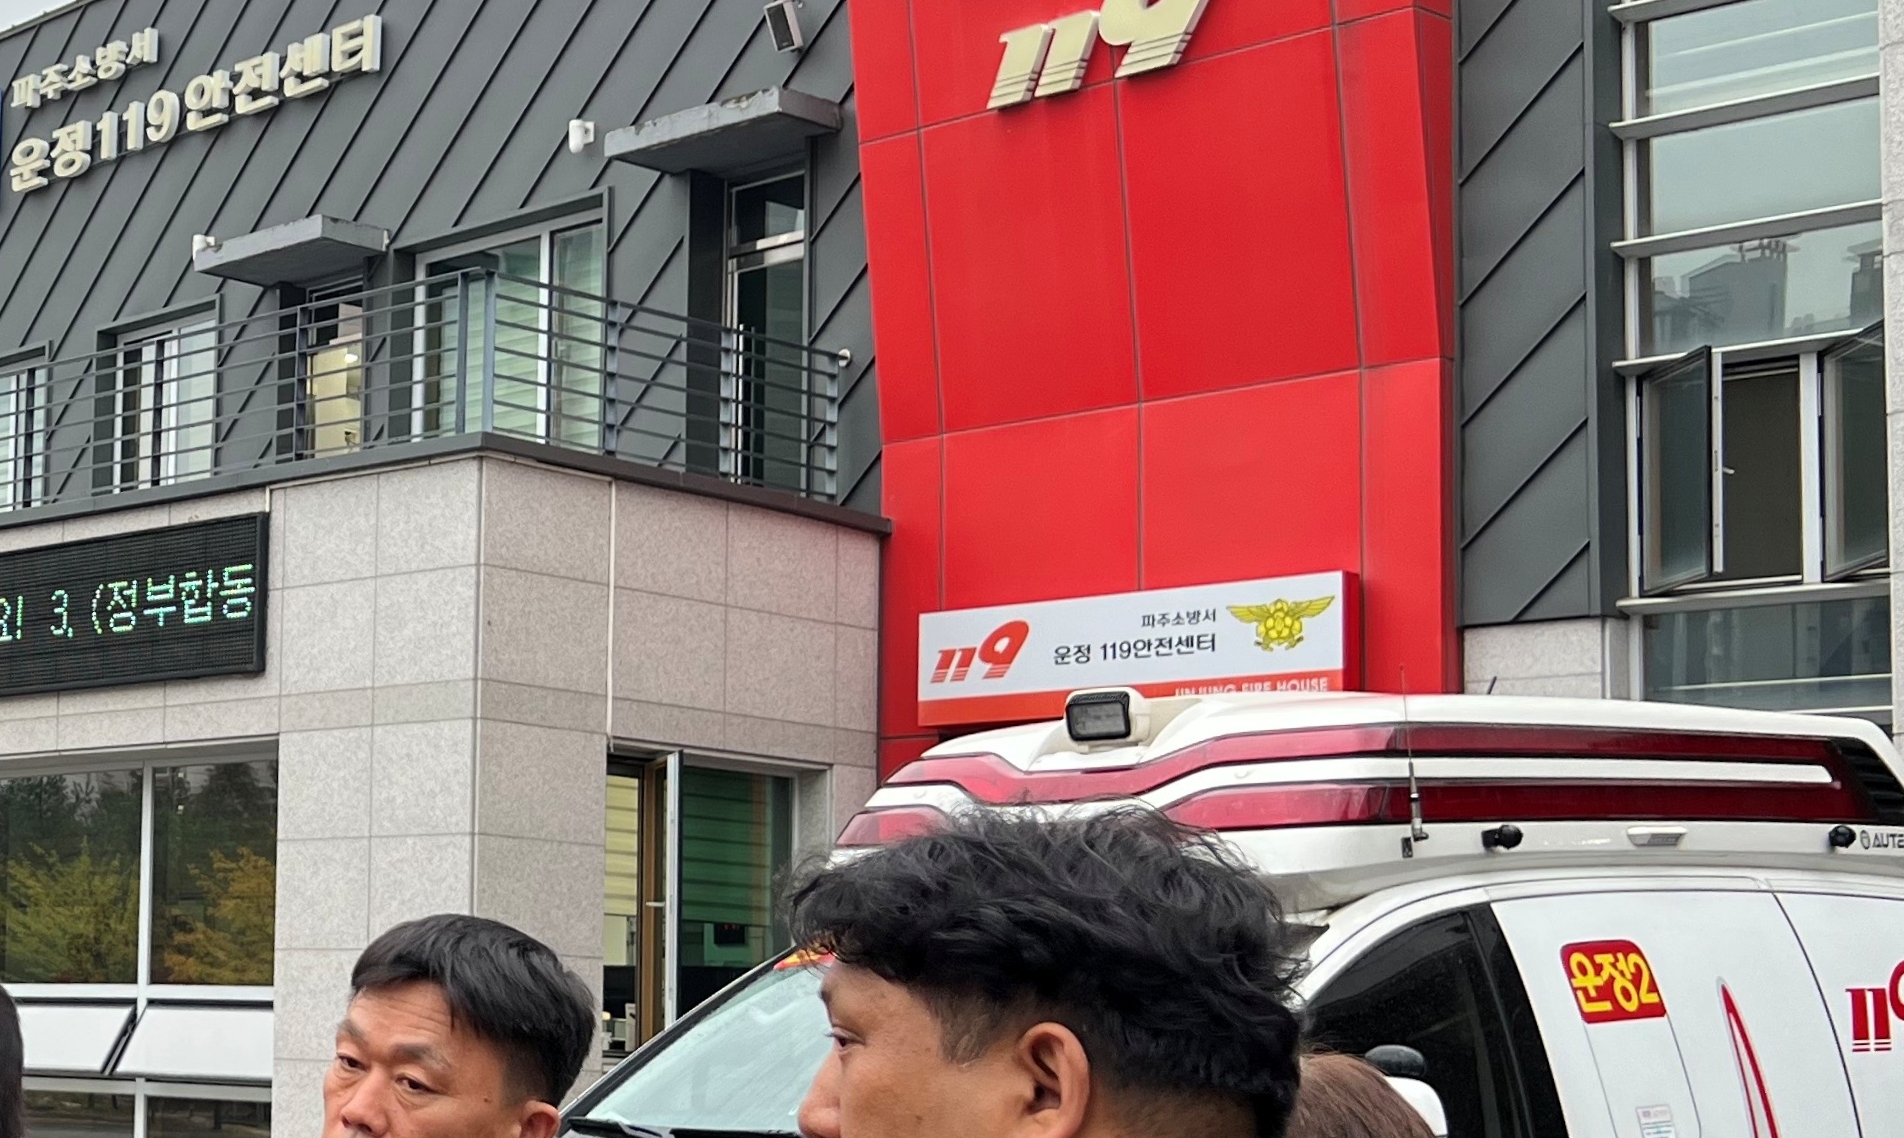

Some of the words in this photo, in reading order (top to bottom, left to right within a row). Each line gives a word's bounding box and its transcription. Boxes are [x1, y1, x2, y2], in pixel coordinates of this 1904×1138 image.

[11, 27, 159, 109] 파주소방서
[92, 563, 256, 634] (정부합동
[1141, 608, 1217, 629] 파주소방서
[929, 619, 1030, 684] 119
[1053, 643, 1092, 665] 운정
[1100, 633, 1217, 661] 119안전센터
[1276, 676, 1329, 692] HOUSE
[1569, 951, 1661, 1013] 운정2
